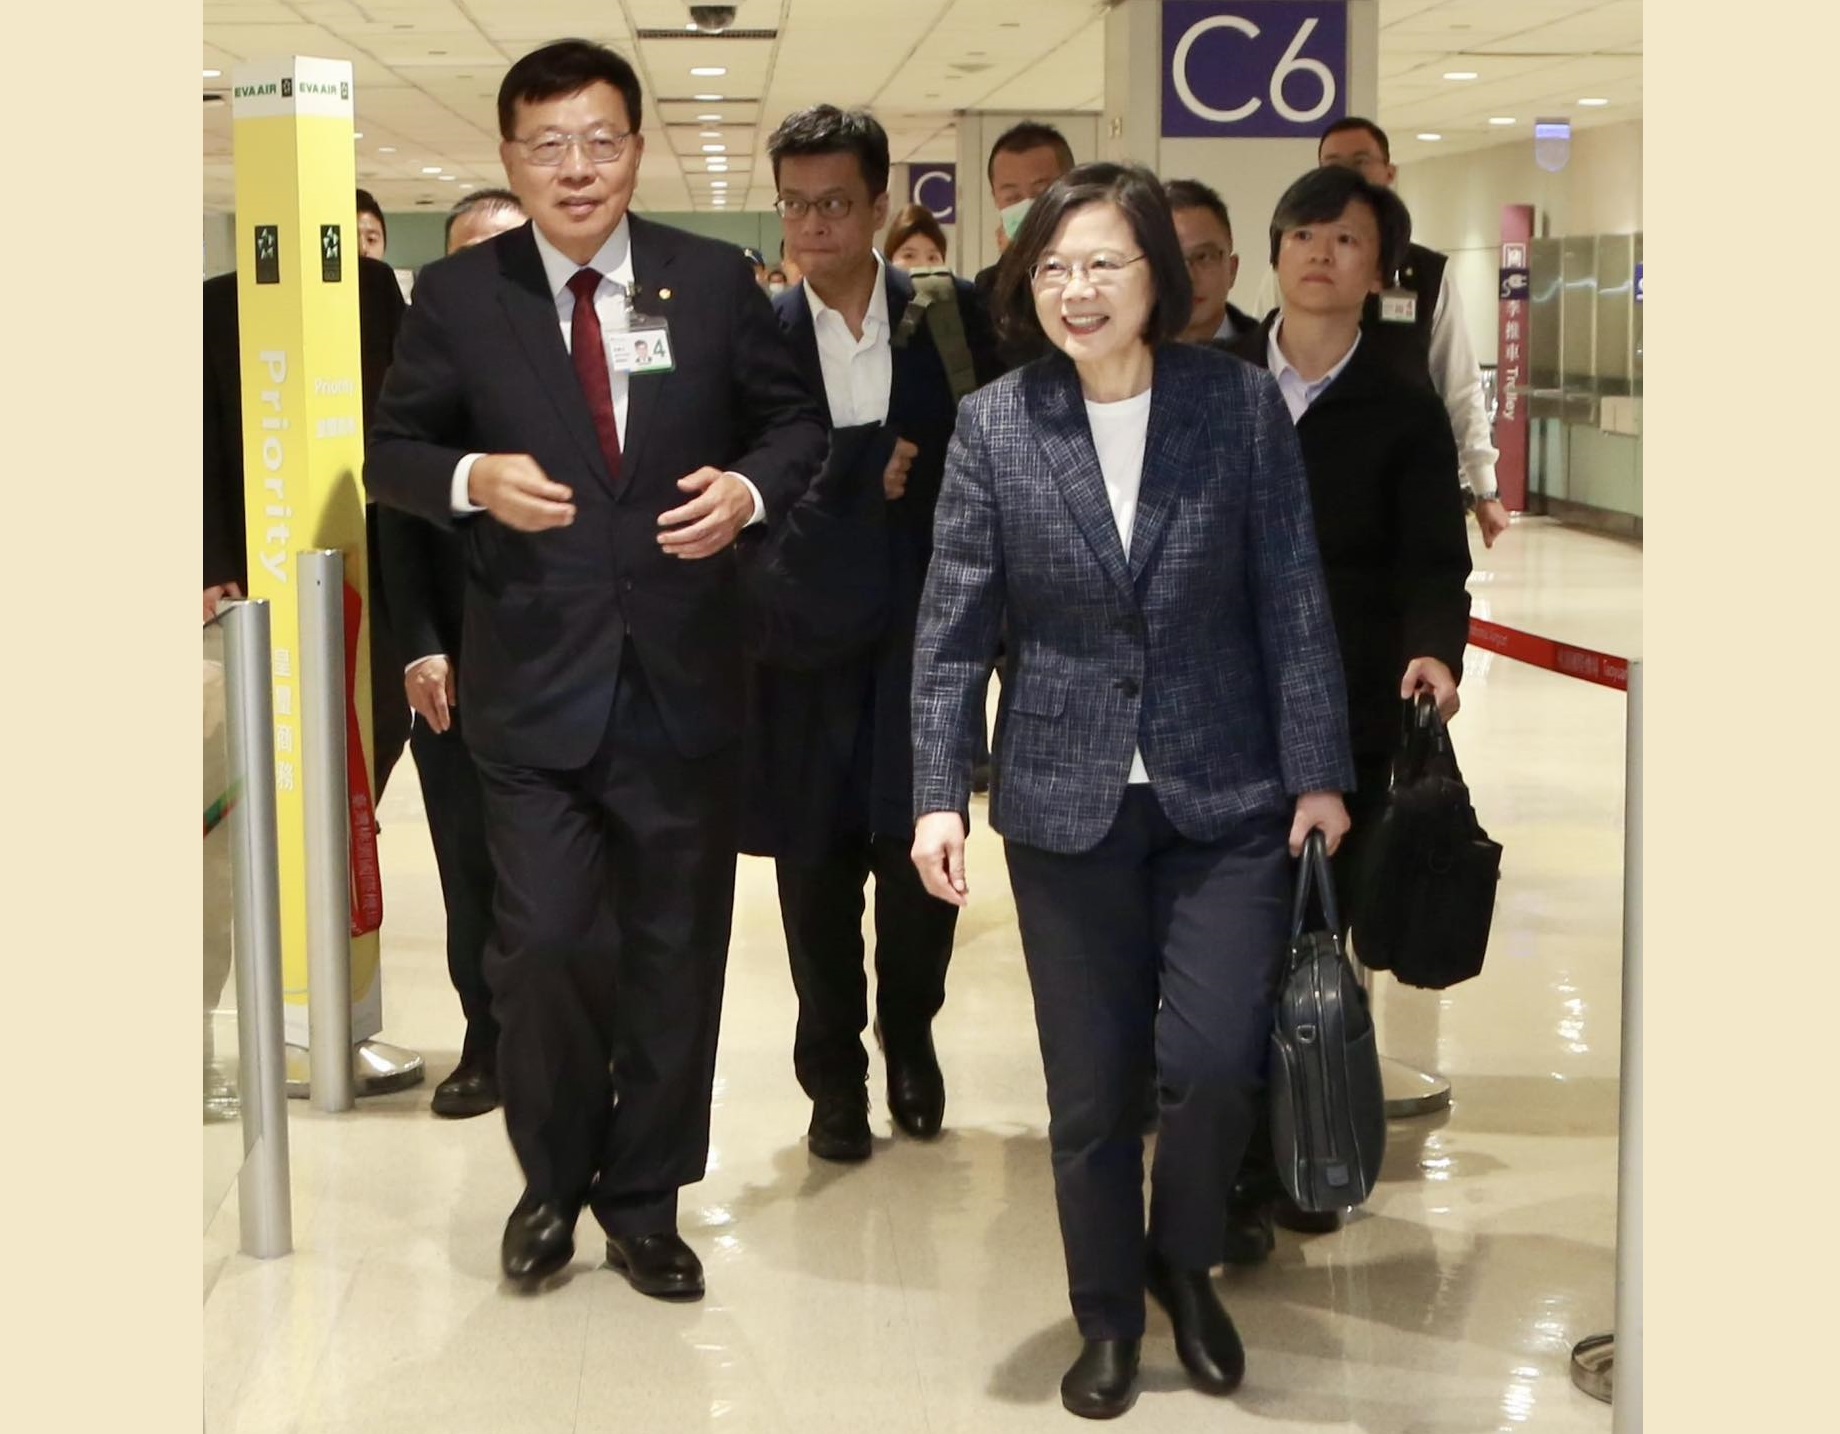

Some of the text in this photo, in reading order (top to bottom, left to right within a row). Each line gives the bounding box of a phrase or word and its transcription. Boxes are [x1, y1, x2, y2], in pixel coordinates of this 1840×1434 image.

[1172, 14, 1337, 124] C6
[234, 83, 277, 98] EVA AIR
[299, 82, 337, 94] EVA AIR
[913, 171, 953, 218] C
[653, 339, 666, 357] 4
[259, 350, 292, 584] Priority
